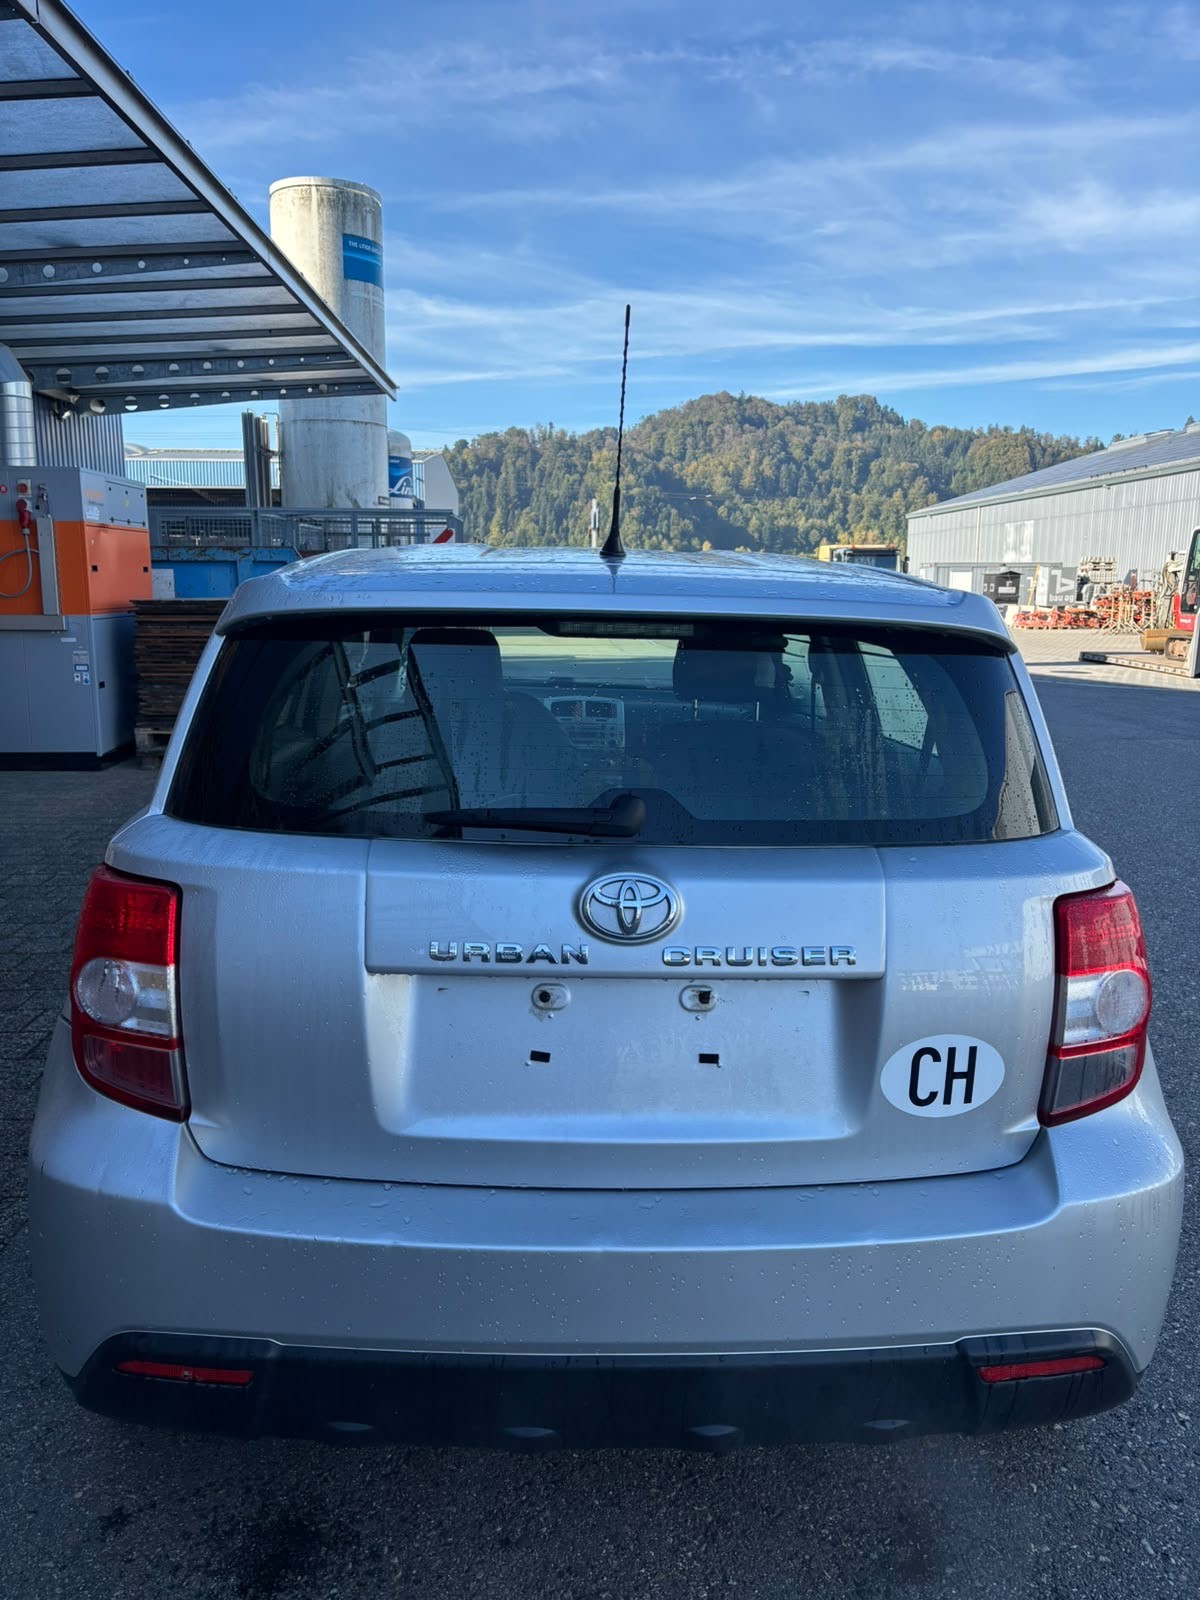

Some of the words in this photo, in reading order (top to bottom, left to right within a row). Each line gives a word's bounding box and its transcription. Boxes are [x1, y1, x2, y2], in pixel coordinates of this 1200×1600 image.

[389, 476, 413, 495] Lin
[1049, 594, 1063, 602] bau
[429, 941, 588, 965] URBAN
[662, 945, 857, 967] CRUISER
[908, 1045, 978, 1107] CH
